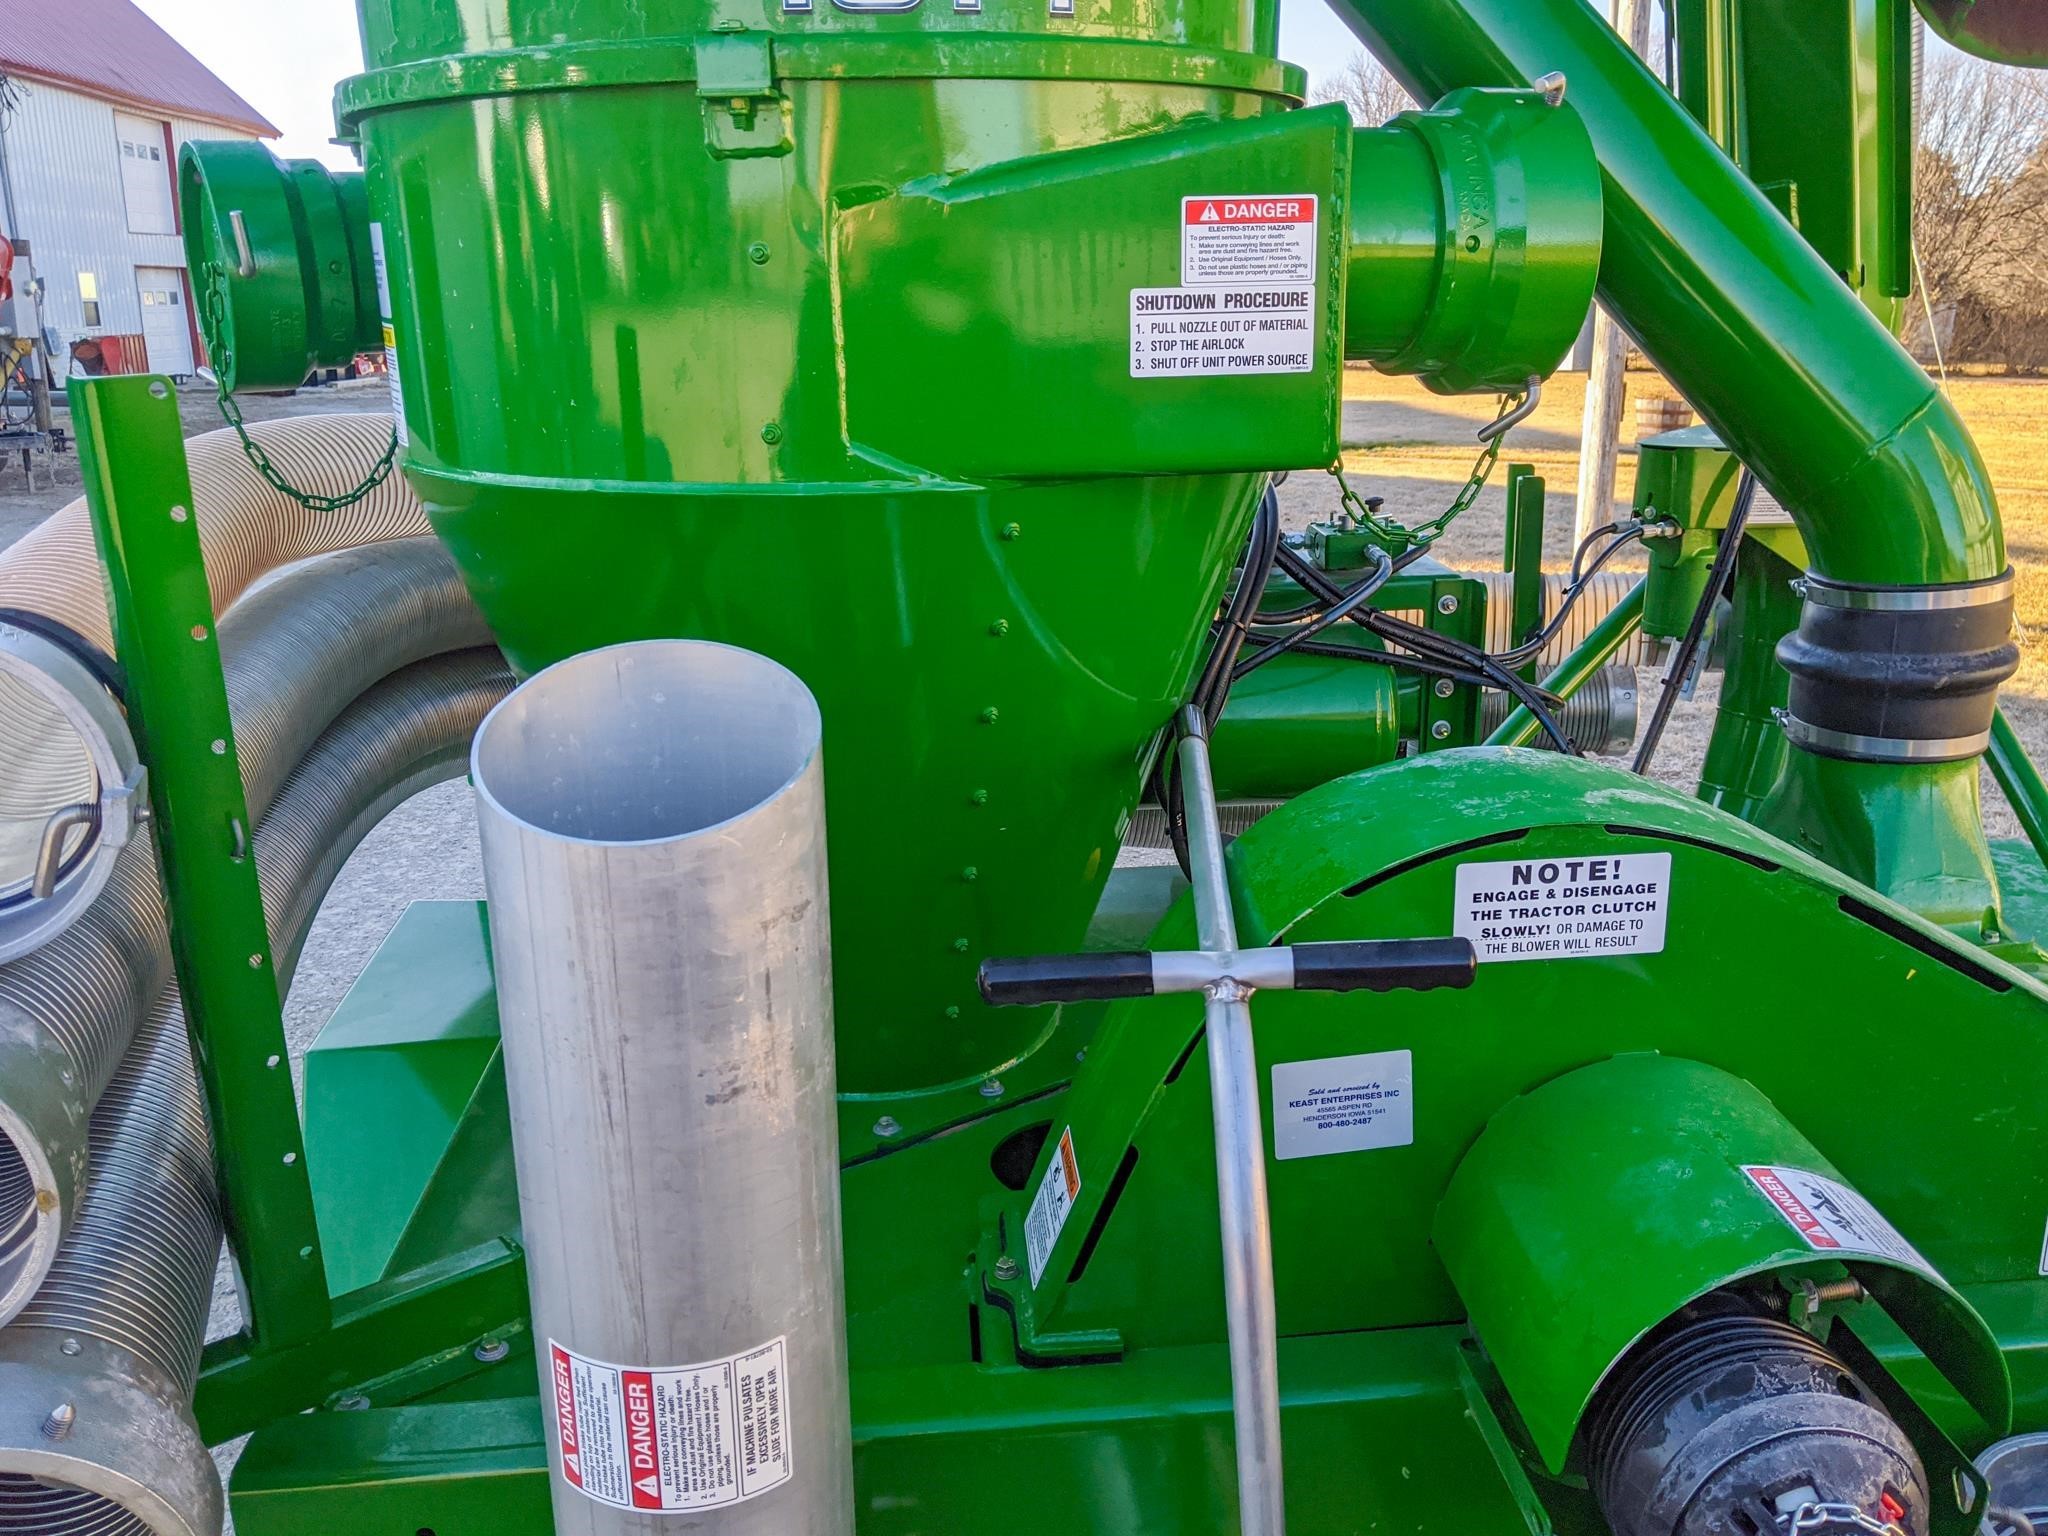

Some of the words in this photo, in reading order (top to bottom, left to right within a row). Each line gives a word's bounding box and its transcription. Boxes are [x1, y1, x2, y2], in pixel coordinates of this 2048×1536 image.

[1225, 203, 1299, 218] DANGER
[1136, 294, 1216, 311] SHUTDOWN
[1224, 291, 1308, 309] PROCEDURE
[1136, 324, 1144, 334] 1.
[1151, 322, 1176, 334] PULL
[1180, 321, 1217, 333] NOZZLE
[1220, 321, 1241, 332] OUT
[1244, 320, 1256, 331] OF
[1259, 319, 1308, 331] MATERIAL
[1136, 341, 1144, 351] 2.
[1151, 340, 1177, 351] STOP
[1180, 340, 1199, 350] THE
[1202, 338, 1244, 350] AIRLOCK
[1136, 359, 1144, 369] 3.
[1151, 357, 1177, 369] SHUT
[1181, 356, 1199, 368] OFF
[1202, 356, 1225, 367] UNIT
[1228, 355, 1264, 367] POWER
[1267, 354, 1308, 365] SOURCE
[1512, 860, 1621, 885] NOTE!
[1472, 890, 1539, 903] ENGAGE
[1547, 889, 1556, 899] &
[1563, 883, 1657, 898] DISENGAGE
[1471, 910, 1502, 921] THE
[1509, 905, 1585, 918] TRACTOR
[1592, 901, 1656, 914] CLUTCH
[1482, 925, 1550, 938] SLOWLY!
[1557, 923, 1572, 934] OR
[1577, 920, 1625, 933] DAMAGE
[1629, 919, 1643, 930] TO
[1486, 943, 1507, 954] THE
[1512, 940, 1560, 953] BLOWER
[1564, 938, 1591, 949] WILL
[1595, 936, 1638, 947] RESULT
[1289, 1099, 1318, 1107] KEAST
[1321, 1092, 1382, 1104] ENTERPRISES
[1304, 1113, 1346, 1122] HENDERSON
[1318, 1117, 1372, 1129] 800-480-2487
[1760, 1175, 1812, 1223] DANGER
[767, 1366, 776, 1385] AIR.
[741, 1375, 752, 1420] PULSATES
[755, 1376, 765, 1401] OPEN
[556, 1358, 575, 1446] DANGER
[657, 1386, 665, 1418] HAZARD
[769, 1388, 778, 1414] MORE
[629, 1384, 653, 1468] DANGER
[757, 1403, 769, 1463] EXCESSIVELY,
[769, 1417, 779, 1434] FOR
[660, 1420, 671, 1485] ELECTRO-STATIC
[744, 1423, 756, 1465] MACHINE
[771, 1437, 781, 1462] SLIDE
[747, 1467, 756, 1476] IF
